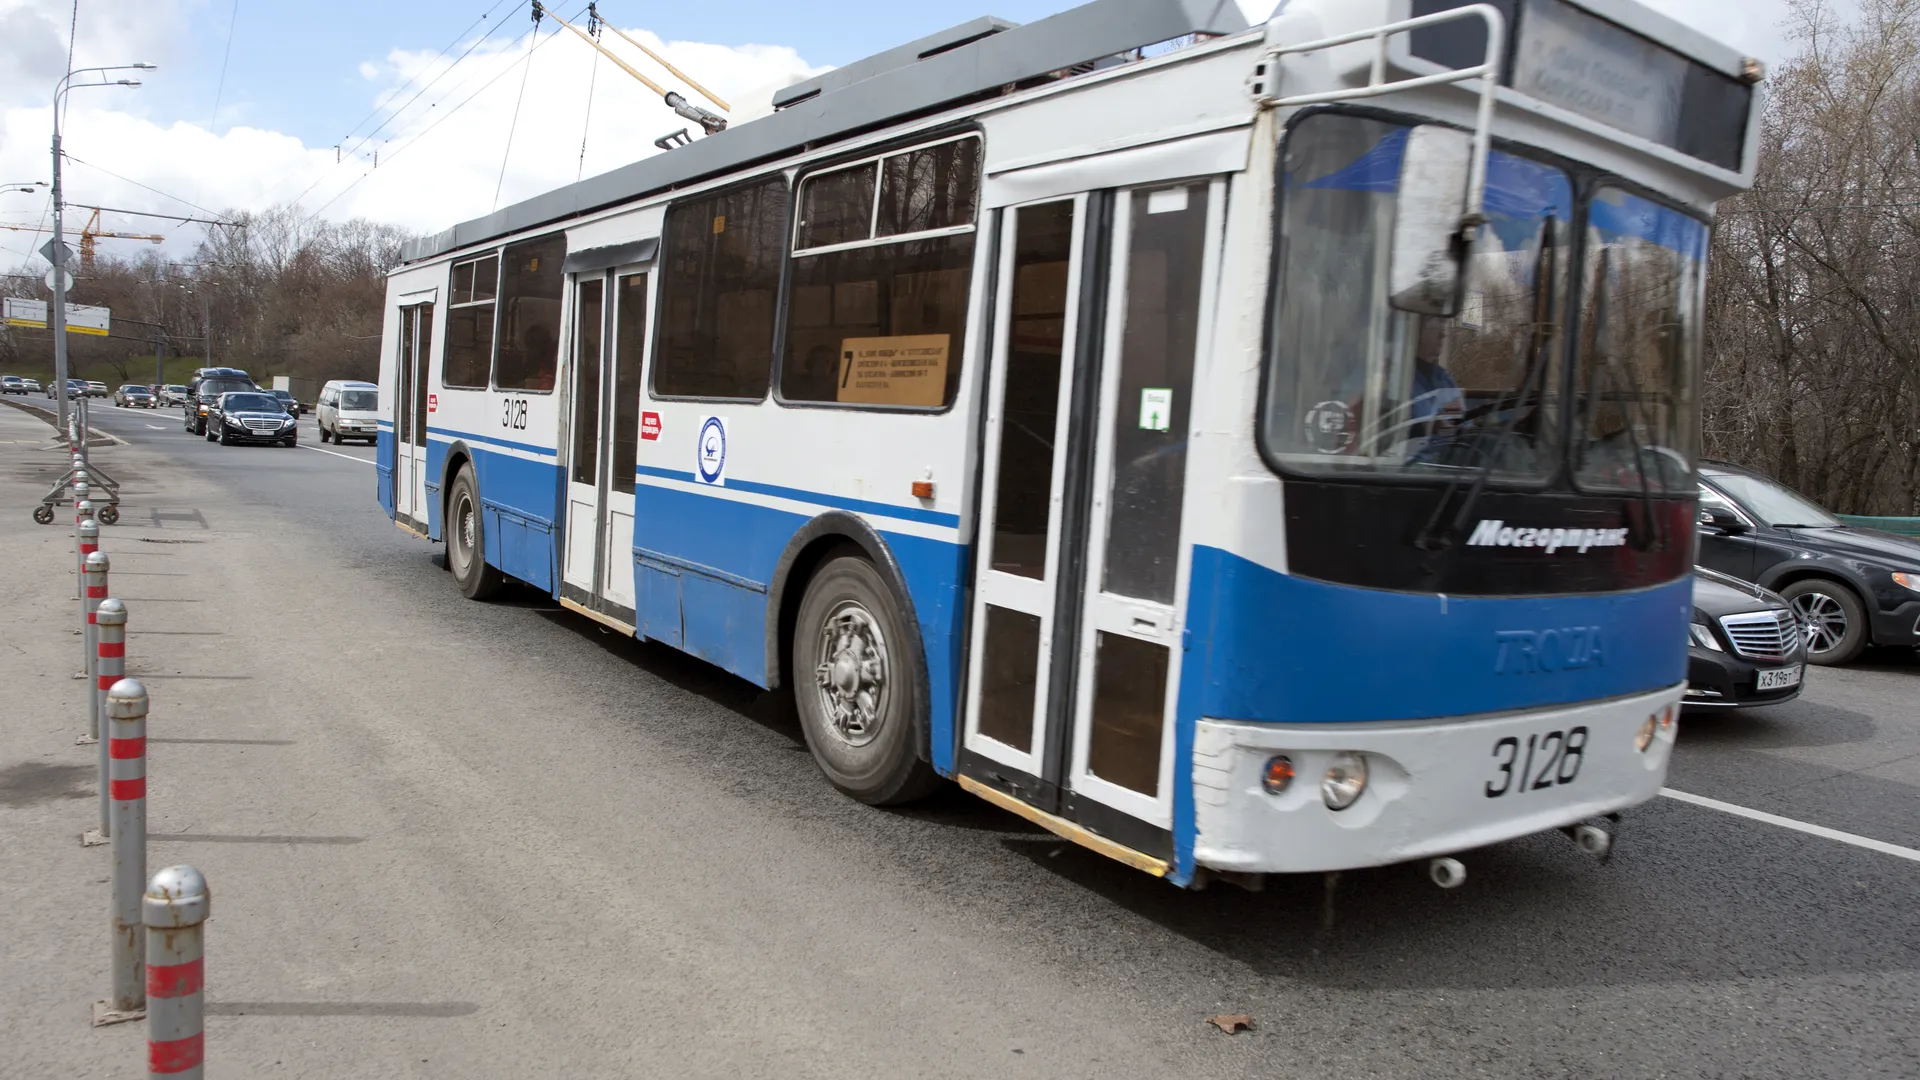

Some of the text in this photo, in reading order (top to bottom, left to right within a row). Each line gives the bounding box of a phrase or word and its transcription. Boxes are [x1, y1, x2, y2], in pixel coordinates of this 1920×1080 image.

[842, 351, 853, 389] 7
[502, 398, 528, 430] 3128
[1465, 519, 1630, 554] Мосгортранс
[1484, 725, 1590, 798] 3128
